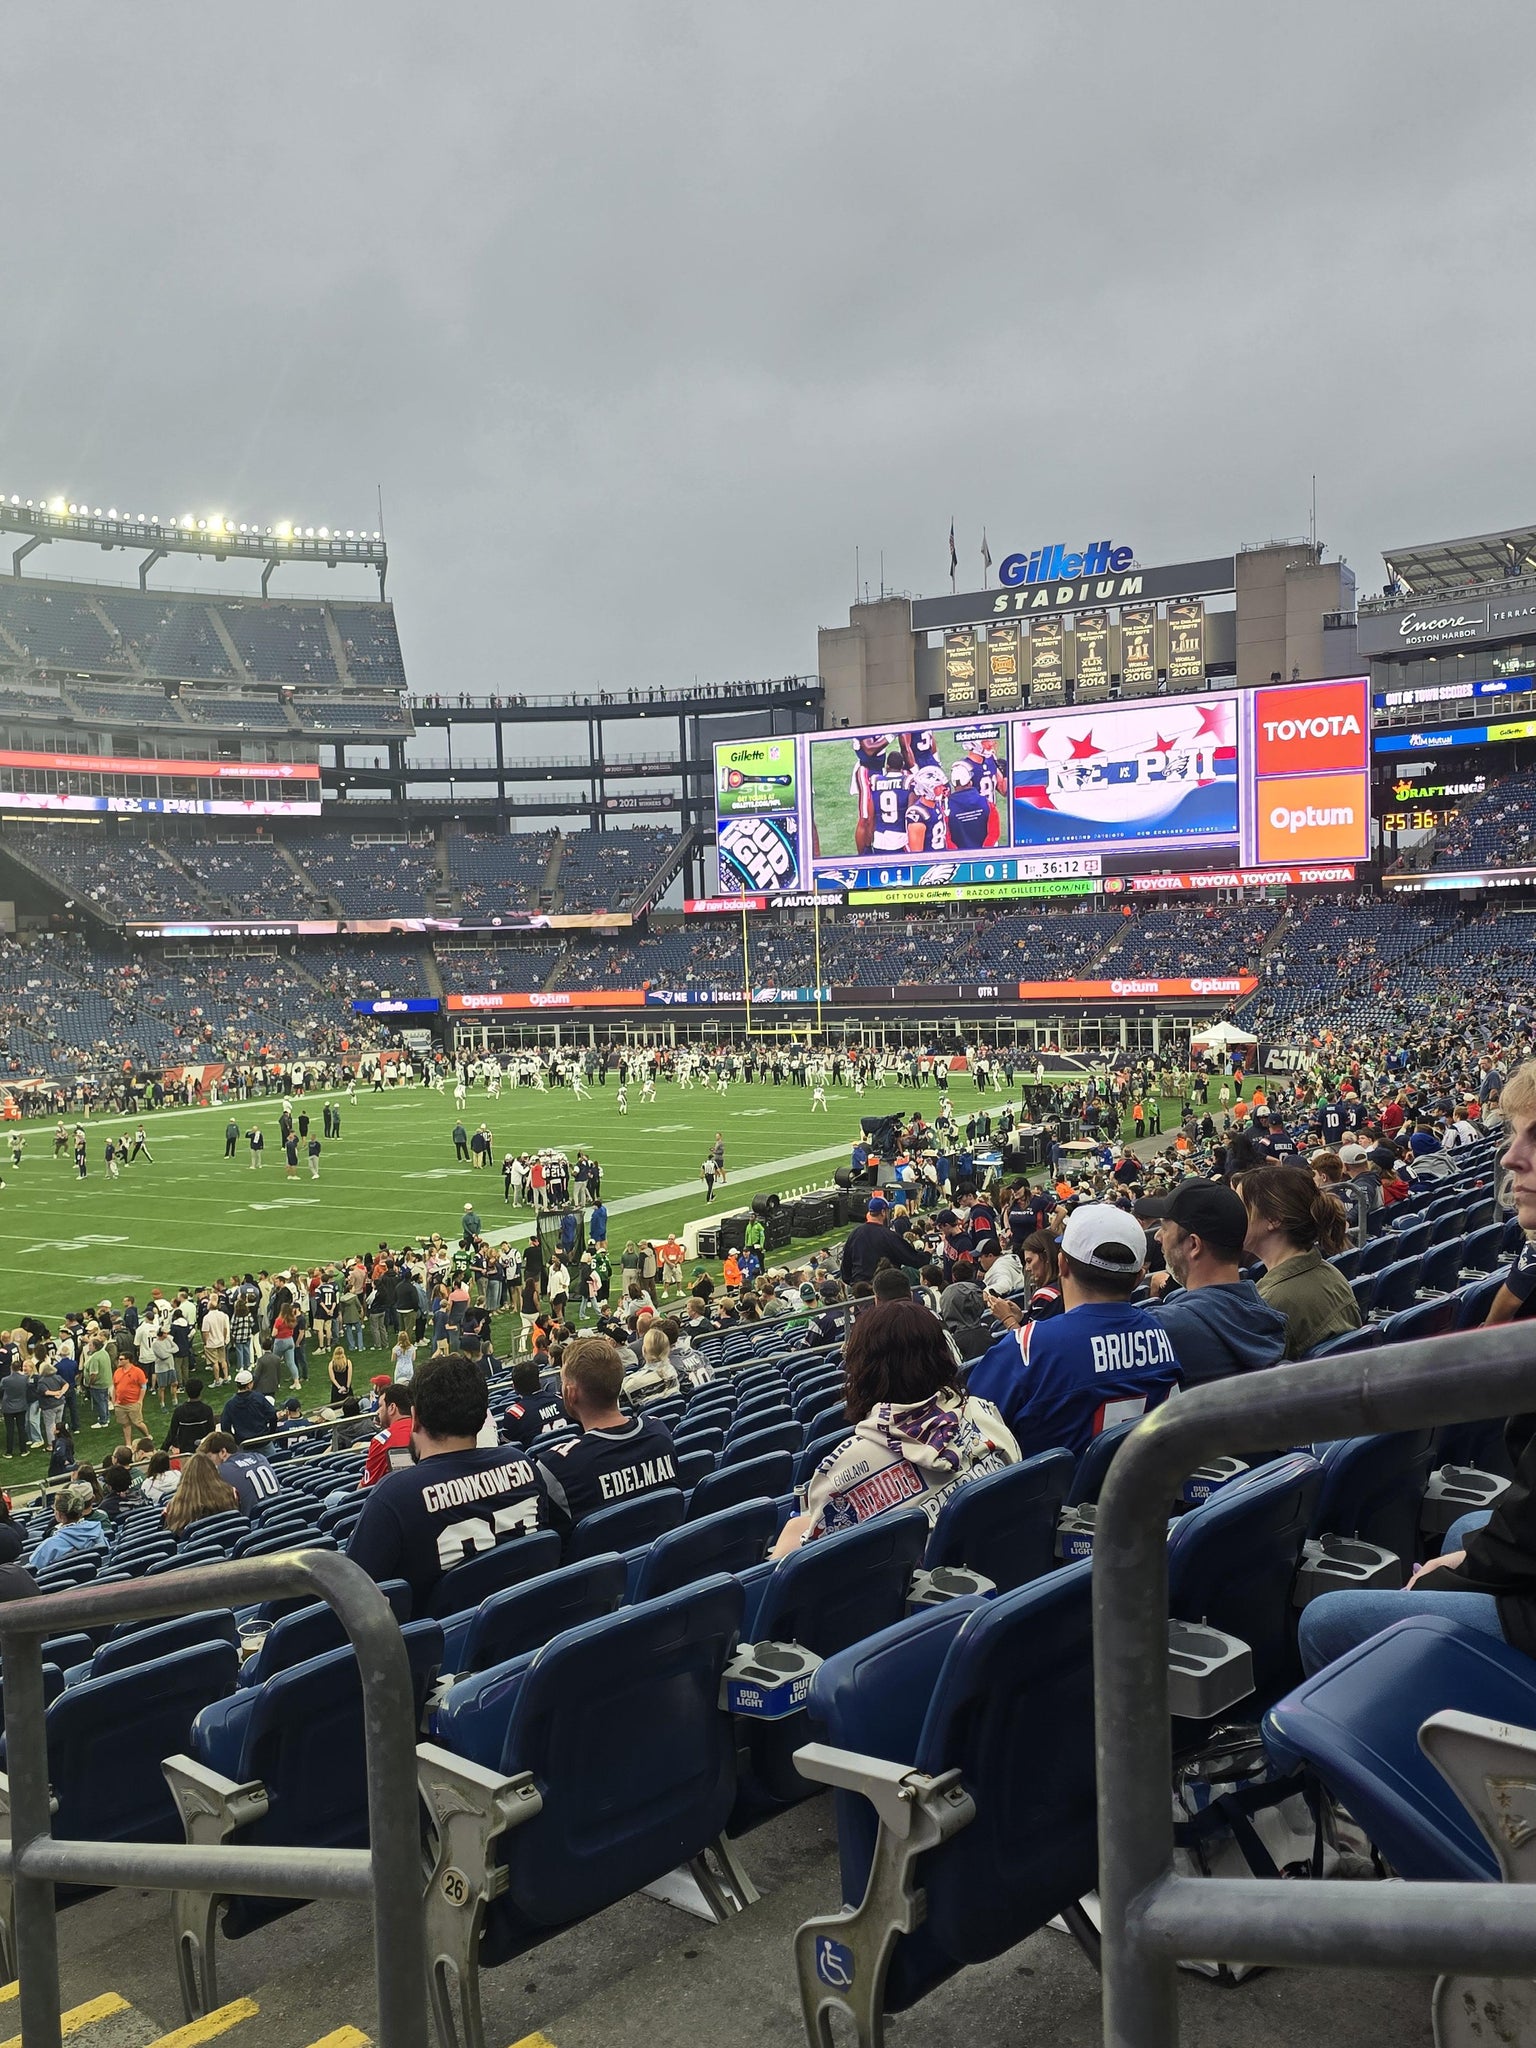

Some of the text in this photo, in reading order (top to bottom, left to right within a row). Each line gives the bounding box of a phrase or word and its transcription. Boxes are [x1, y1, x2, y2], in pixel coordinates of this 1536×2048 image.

[999, 540, 1134, 588] Gillette
[993, 576, 1144, 612] STADIUM
[1399, 612, 1484, 636] Encore
[1406, 629, 1477, 644] BOSTON HARBOR
[1125, 671, 1152, 682] 2016
[1171, 666, 1200, 677] 2018
[1033, 682, 1062, 693] 2004
[1079, 677, 1106, 687] 2014
[948, 691, 974, 702] 2001
[990, 687, 1017, 697] 2003
[1385, 683, 1474, 706] OUT OF TOWN SCORES
[955, 730, 998, 741] ticketmaster
[1262, 714, 1361, 742] TOYOTA
[1427, 735, 1453, 745] Mutual
[730, 750, 765, 762] Gillette
[220, 768, 239, 776] BANK
[249, 768, 280, 776] AMERICA
[1046, 746, 1217, 794] NE VS. PHI
[1395, 782, 1486, 802] DRAFTKINGS
[618, 799, 637, 807] 2021
[880, 790, 898, 823] 9
[1269, 805, 1354, 834] Optum
[1385, 813, 1406, 831] 25
[738, 818, 790, 876] BUD
[880, 870, 889, 885] 0
[984, 864, 995, 878] 0
[1042, 860, 1079, 874] 36:12
[1135, 869, 1352, 890] TOYOTA TOYOTA TOYOTA TOYOTA
[1010, 882, 1090, 895] GILLETTE.COM/NFL
[706, 903, 723, 911] new
[784, 894, 844, 907] AUTODESK
[978, 986, 993, 998] QTR
[1110, 978, 1241, 995] Optum Optum
[462, 992, 570, 1009] Optum Optum
[674, 993, 688, 1002] NE
[700, 992, 708, 1001] 0
[717, 992, 742, 1001] 36:12
[781, 990, 798, 999] PHI
[1325, 1113, 1340, 1128] 10
[550, 1168, 560, 1178] 21
[456, 1260, 467, 1271] 26
[1090, 1328, 1175, 1373] BRUSCHI
[538, 1403, 560, 1420] MAYE
[598, 1454, 676, 1500] EDELMAN
[833, 1459, 870, 1488] ENGLAND
[245, 1464, 279, 1500] 10
[421, 1459, 535, 1514] GRONKOWSKI
[1193, 1485, 1210, 1493] BUD
[844, 1459, 921, 1522] ATRIOTS
[1190, 1491, 1214, 1499] LIGHT
[1073, 1541, 1091, 1549] BUD
[736, 1696, 764, 1708] LIGHT
[739, 1689, 760, 1700] BUD
[444, 1874, 464, 1901] 26
